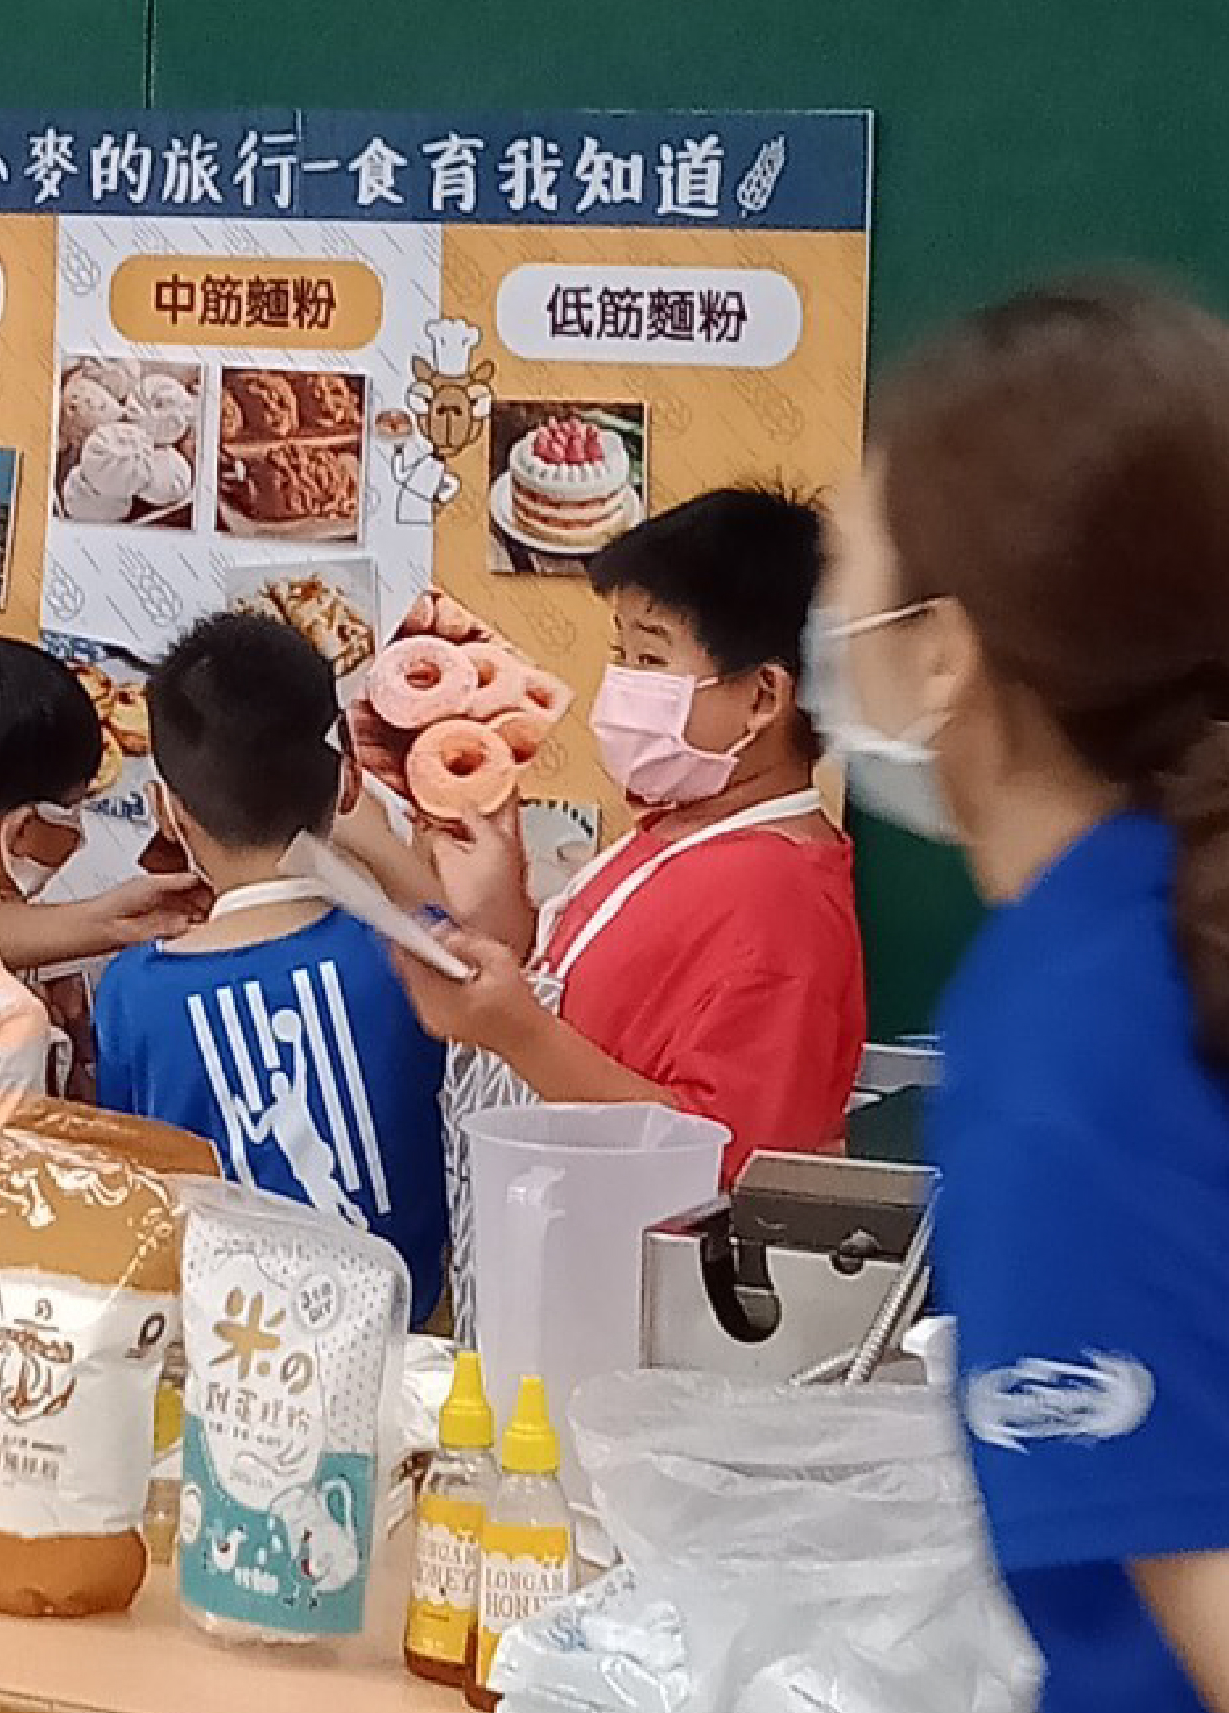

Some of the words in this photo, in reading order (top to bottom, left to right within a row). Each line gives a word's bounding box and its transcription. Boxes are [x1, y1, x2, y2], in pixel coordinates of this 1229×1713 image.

[154, 272, 337, 331] 中筋麵粉
[546, 283, 748, 343] 低筋麵粉
[485, 1567, 565, 1592] LONGAN
